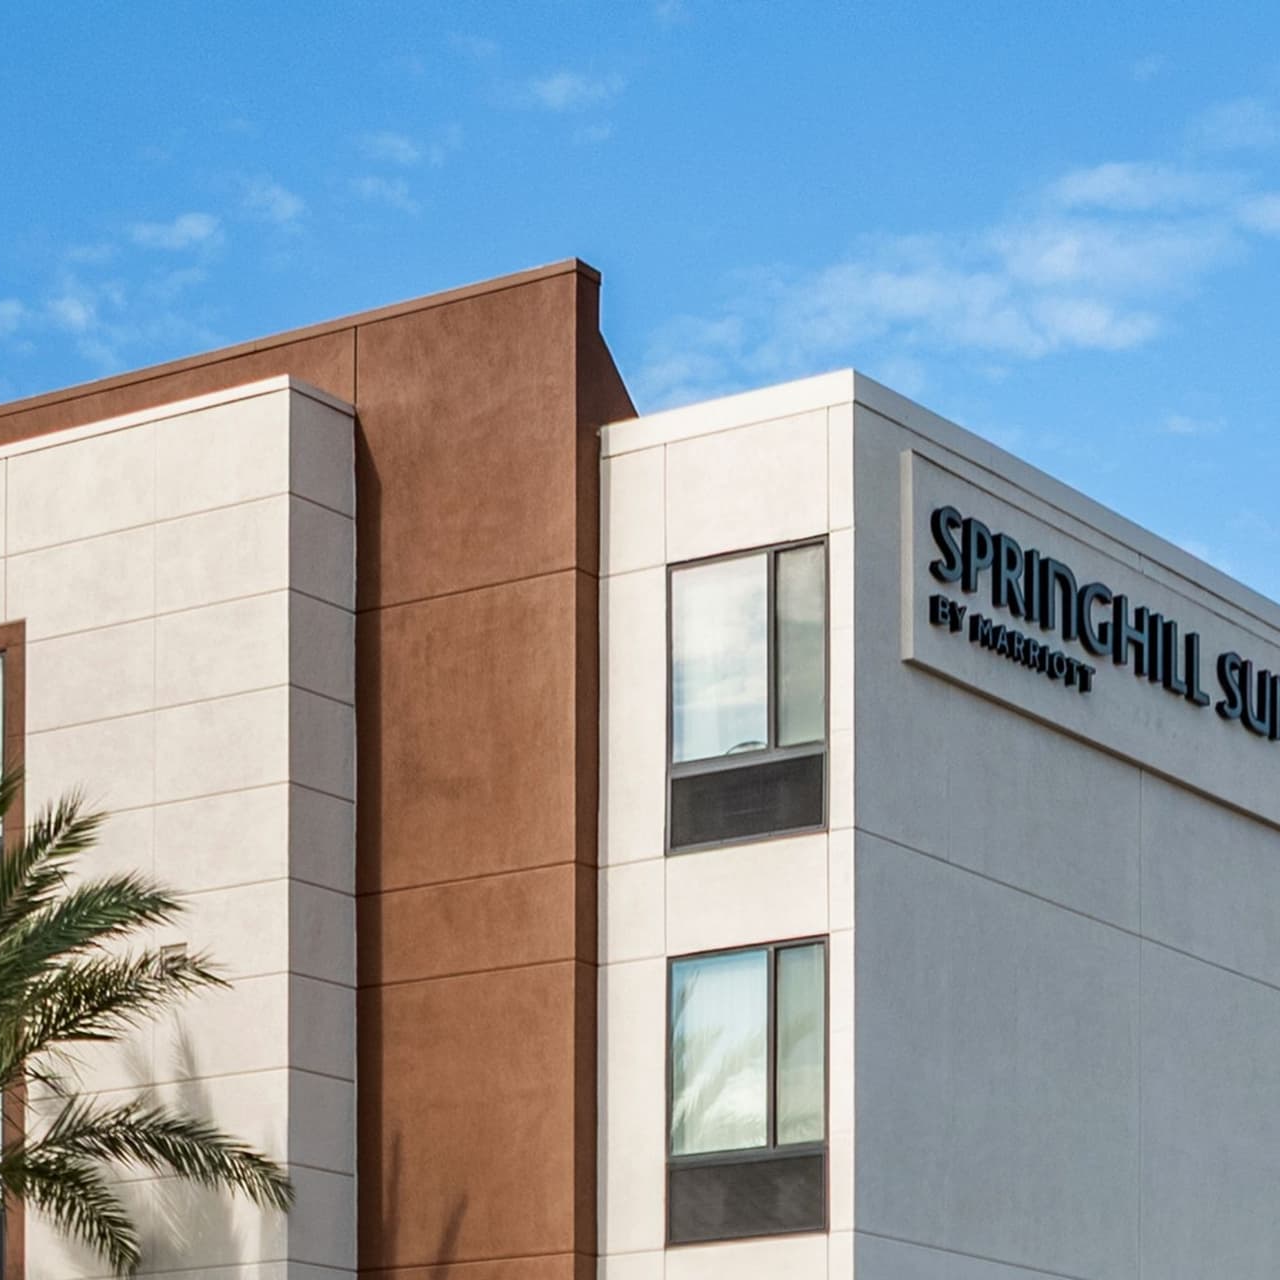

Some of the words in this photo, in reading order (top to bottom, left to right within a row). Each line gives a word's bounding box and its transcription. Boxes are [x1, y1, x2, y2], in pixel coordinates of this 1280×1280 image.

[929, 505, 1211, 708] SPRINGHILL
[929, 592, 968, 633] BY
[969, 613, 1096, 693] MARRIOTT
